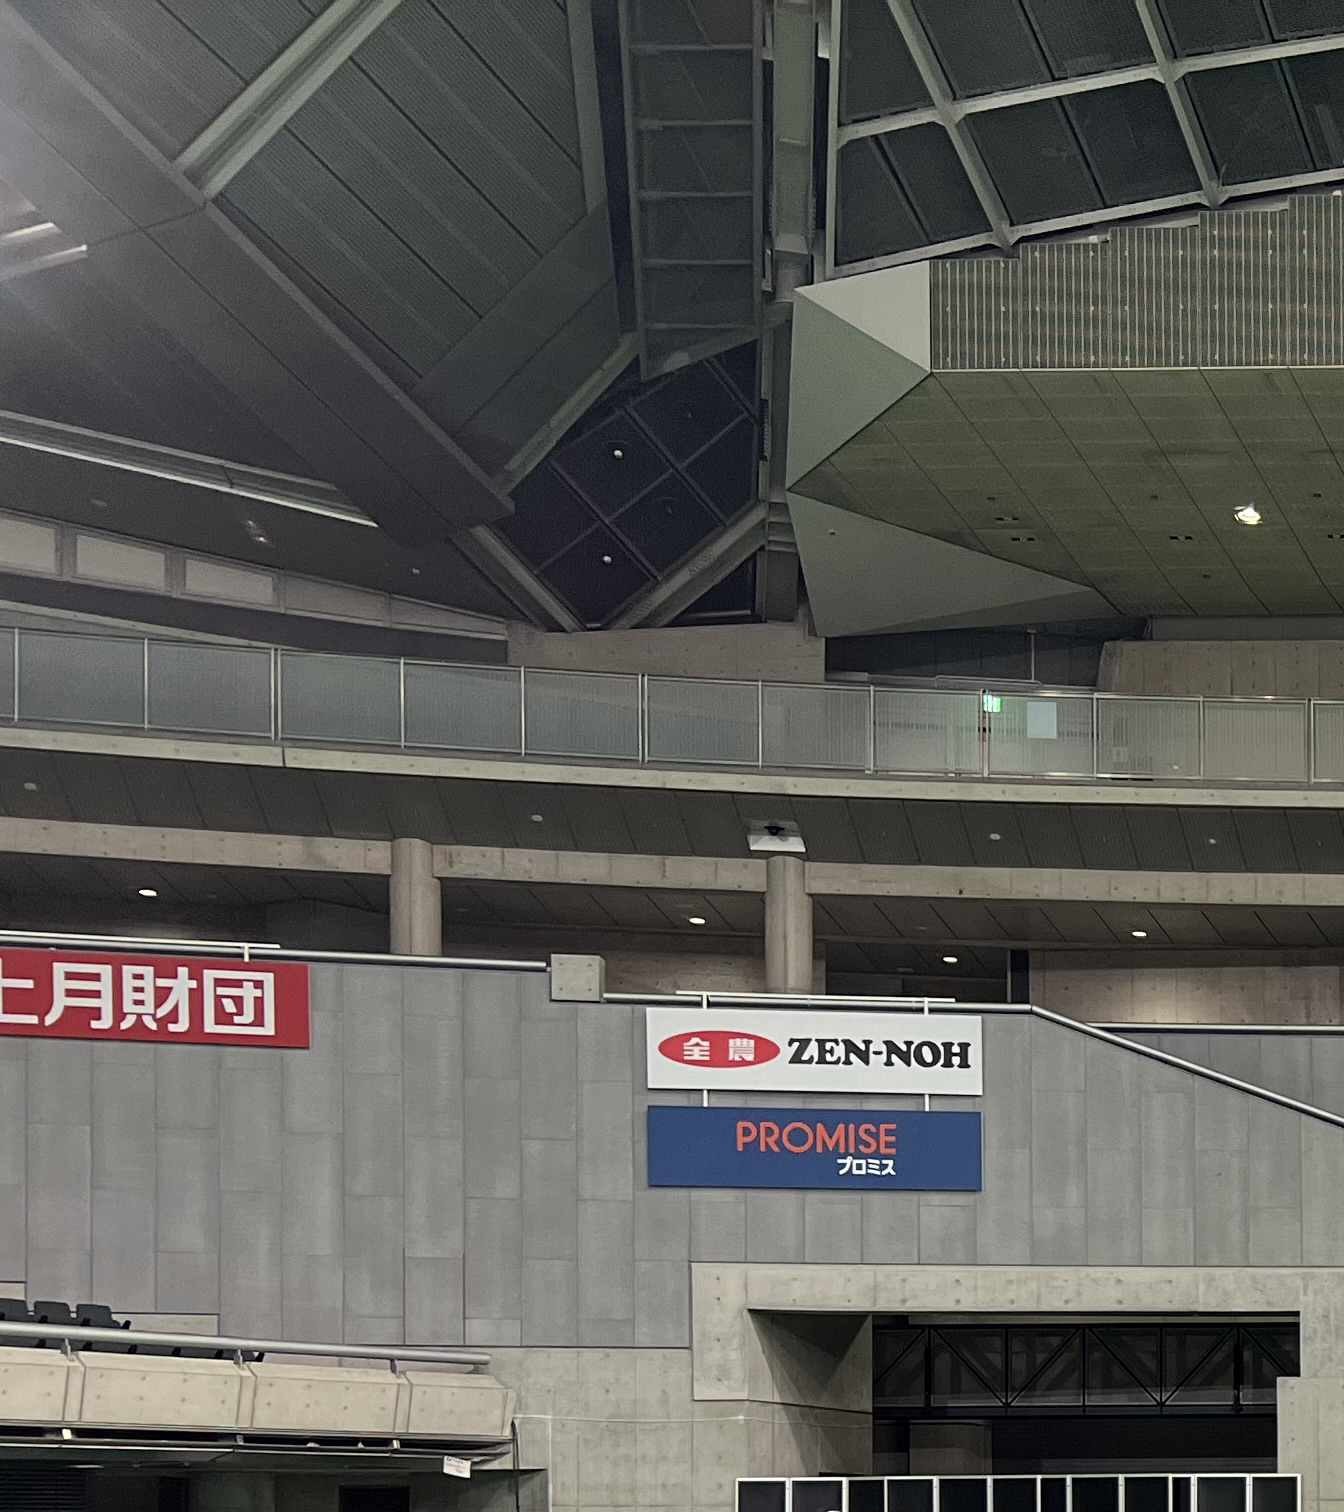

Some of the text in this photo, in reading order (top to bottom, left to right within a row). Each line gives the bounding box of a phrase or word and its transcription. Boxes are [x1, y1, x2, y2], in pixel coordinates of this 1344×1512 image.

[788, 1038, 972, 1069] ZEN-NOH
[736, 1120, 897, 1155] PROMISE
[837, 1156, 896, 1176] プロミス
